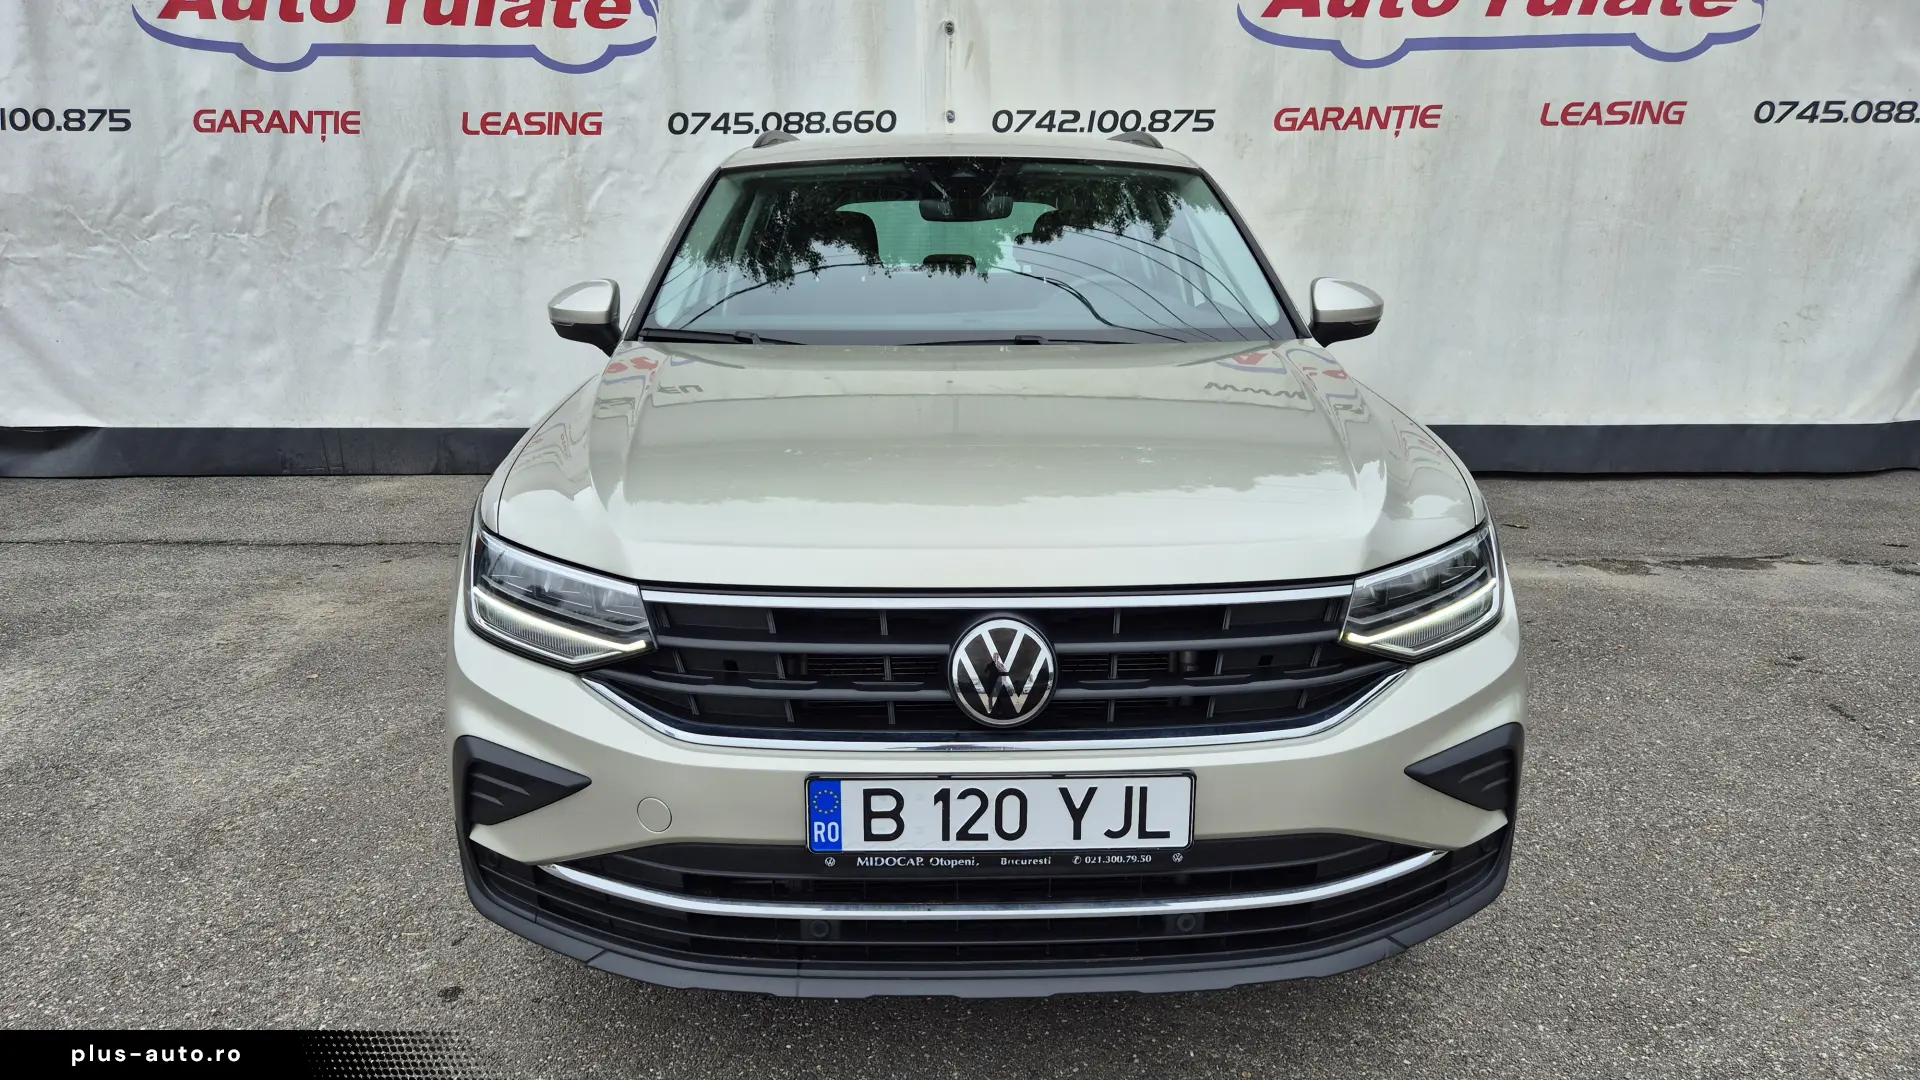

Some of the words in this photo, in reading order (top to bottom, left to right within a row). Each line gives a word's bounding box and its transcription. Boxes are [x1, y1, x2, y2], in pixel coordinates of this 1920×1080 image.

[193, 109, 361, 142] GARANȚIE
[461, 111, 604, 136] LEASING
[668, 110, 897, 135] 0745.088.660
[992, 109, 1216, 133] 0742.100.875
[1273, 104, 1442, 137] GARANȚIE
[1540, 100, 1688, 127] LEASING
[862, 788, 905, 842] B
[933, 788, 1028, 842] 120
[1058, 786, 1171, 841] YJL
[813, 821, 840, 843] RO
[1084, 854, 1152, 864] 021.300.79.50
